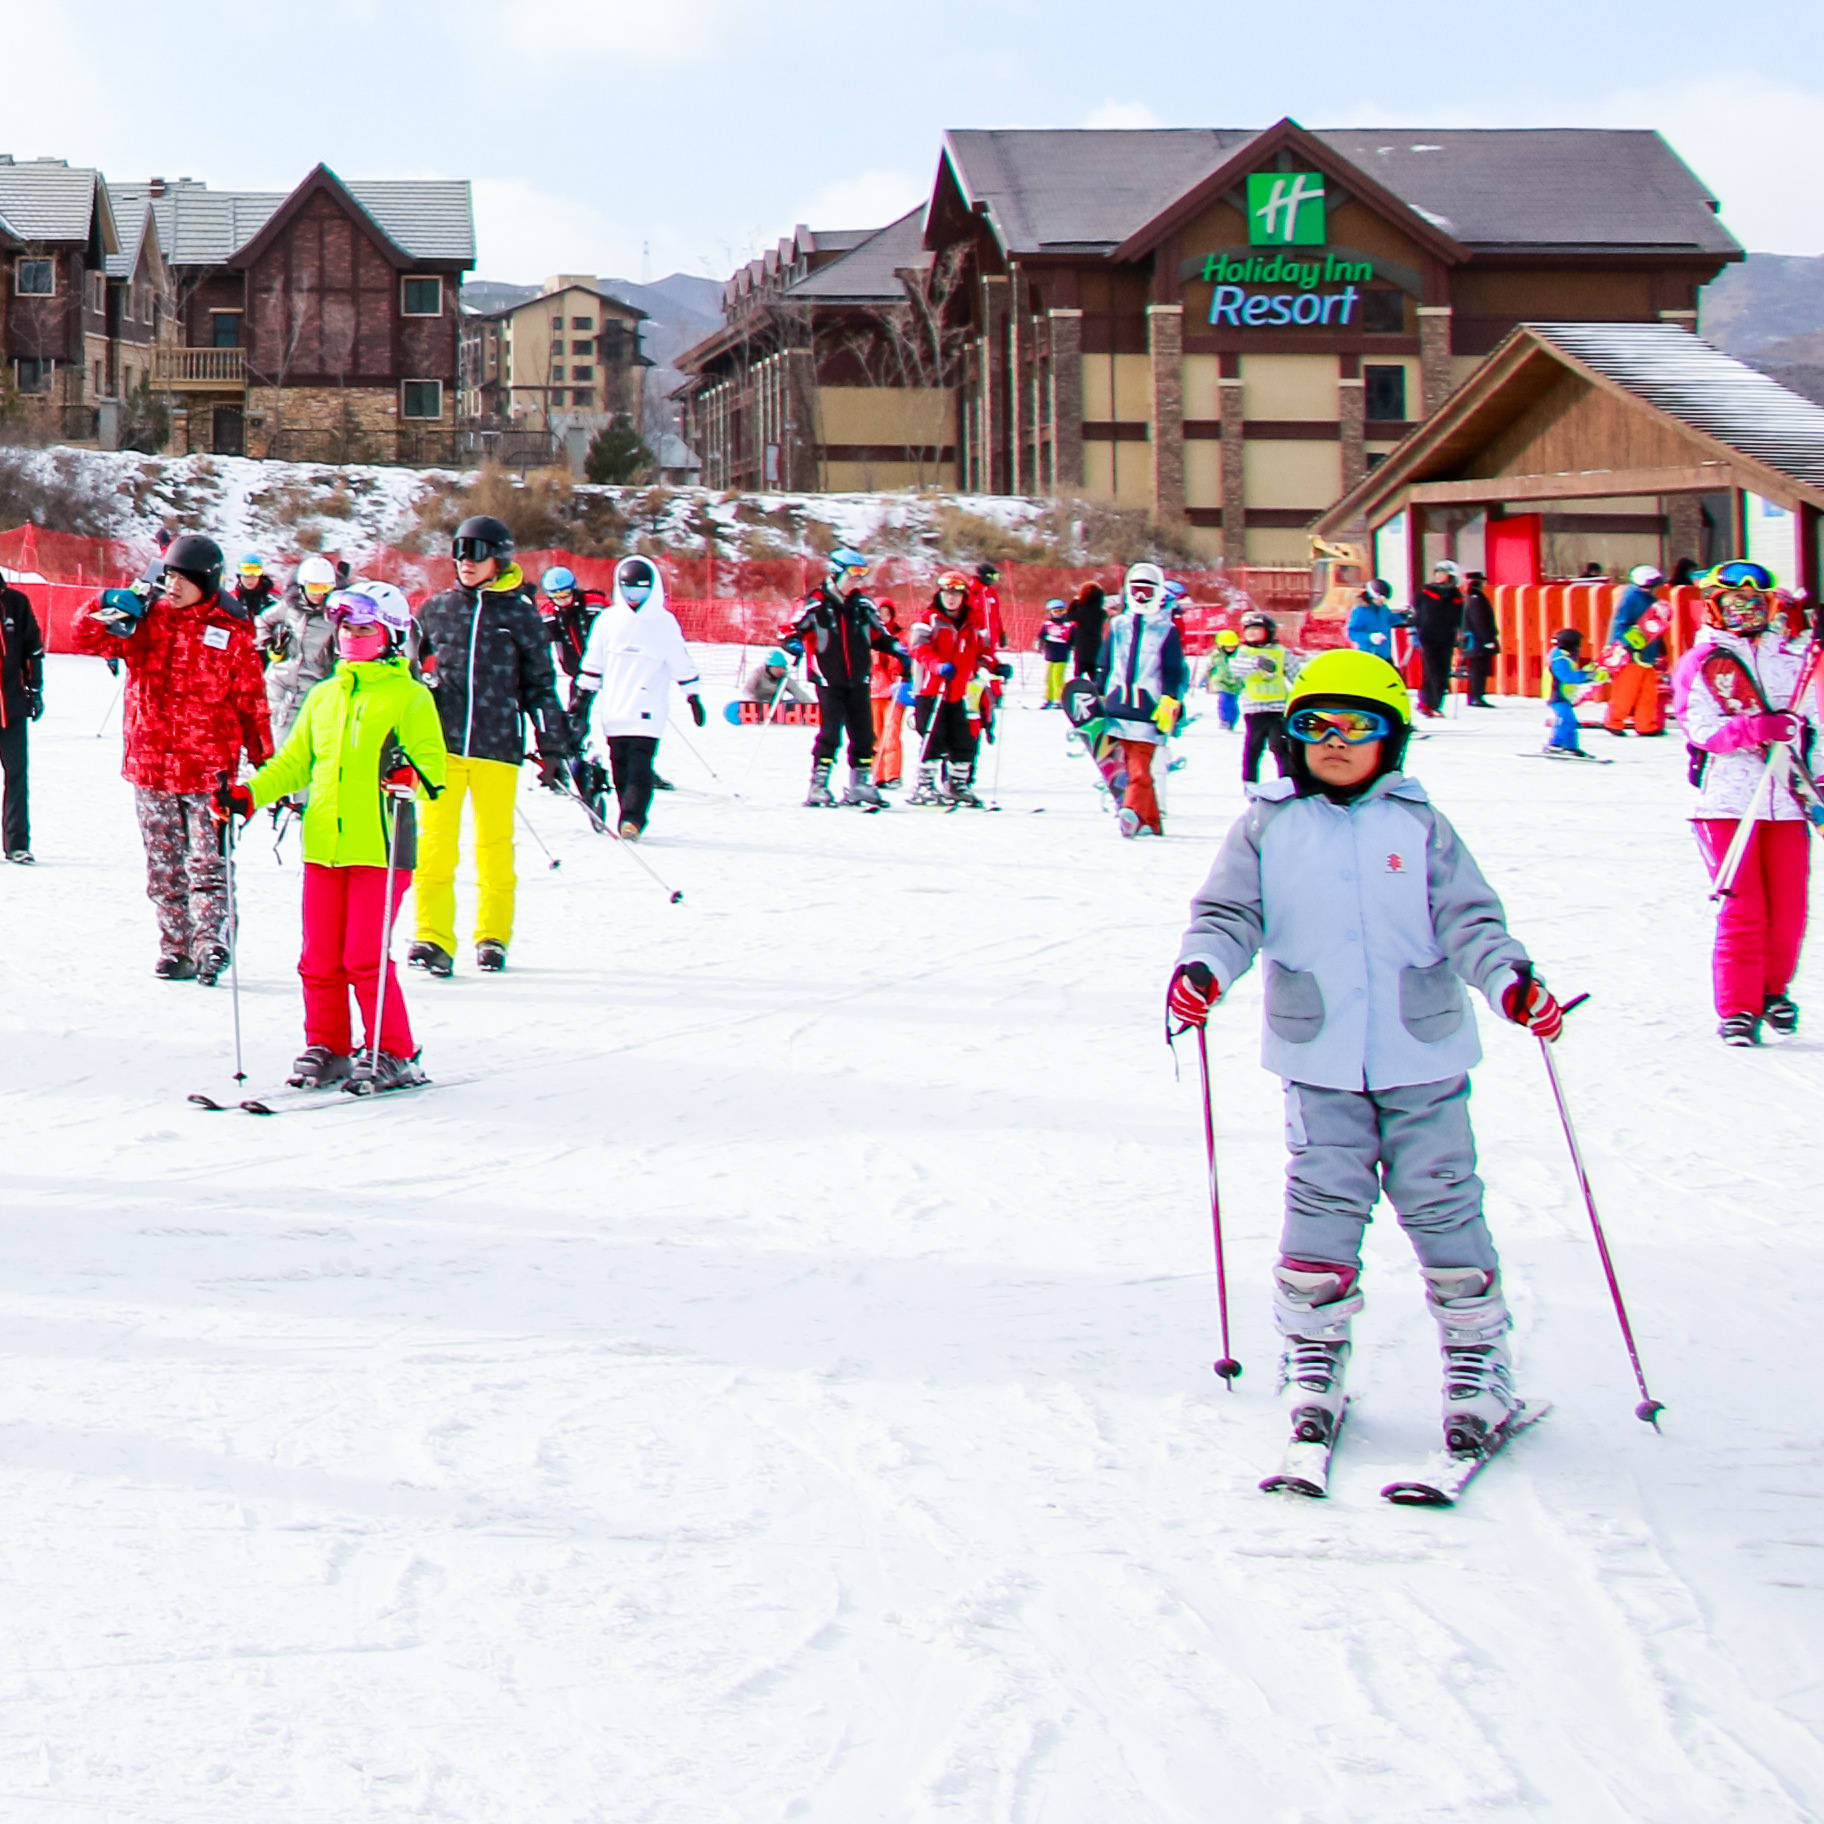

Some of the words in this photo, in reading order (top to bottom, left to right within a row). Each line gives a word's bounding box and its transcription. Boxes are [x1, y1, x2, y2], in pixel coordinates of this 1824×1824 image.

[1201, 252, 1318, 291] Holiday
[1322, 253, 1373, 284] Inn
[1208, 284, 1360, 328] Resort
